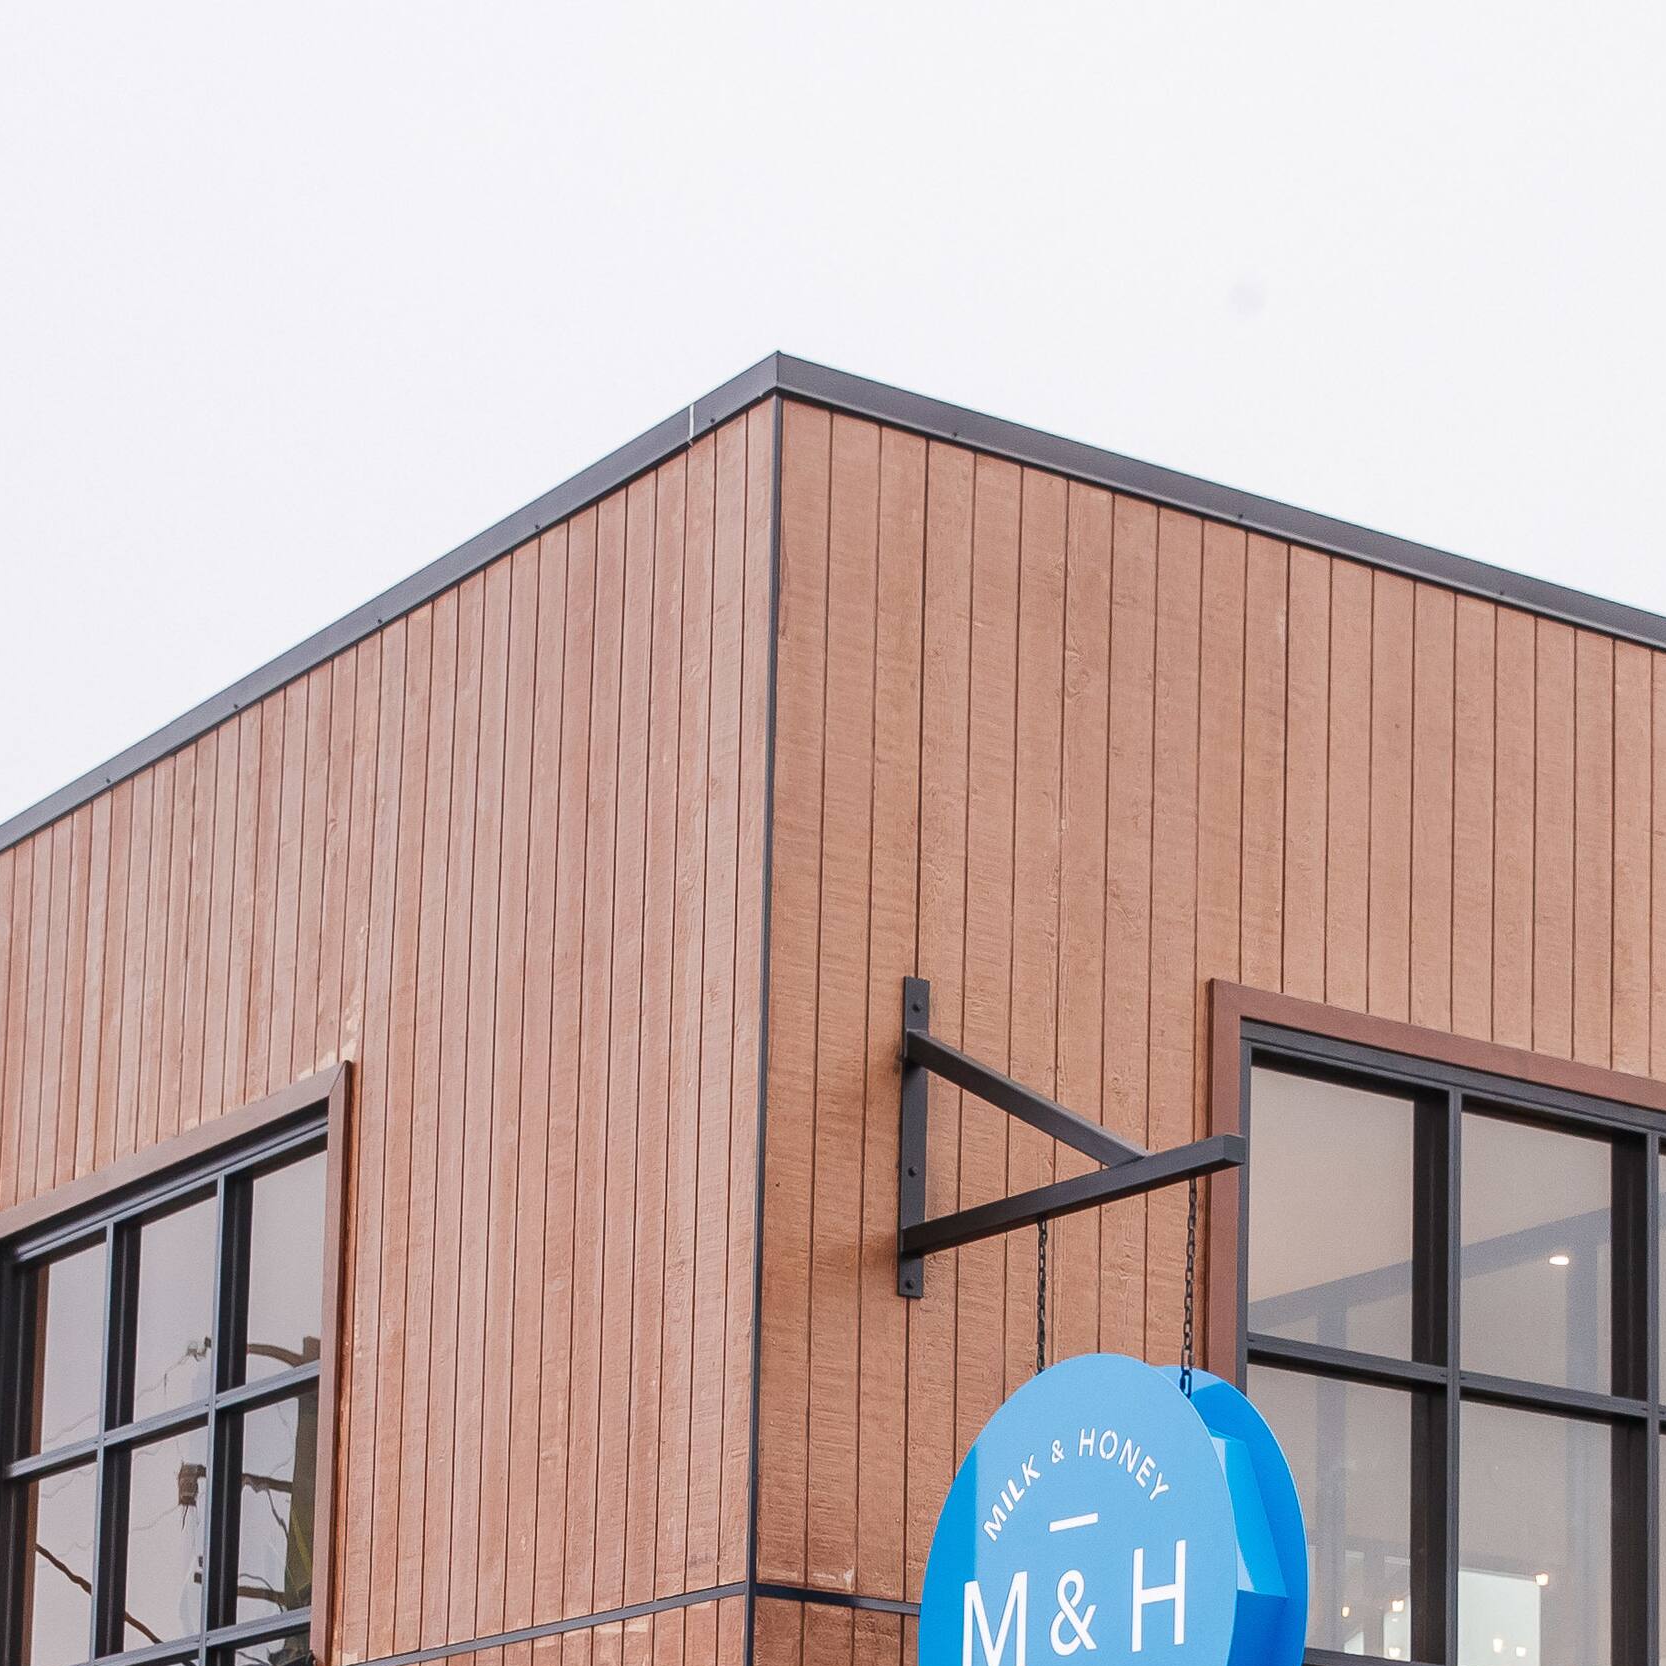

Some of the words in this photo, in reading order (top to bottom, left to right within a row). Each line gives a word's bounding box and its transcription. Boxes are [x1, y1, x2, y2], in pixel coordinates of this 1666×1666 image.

[983, 1454, 1041, 1541] MILK
[1051, 1439, 1065, 1464] &
[1078, 1427, 1169, 1501] HONEY
[1049, 1569, 1097, 1656] &
[1131, 1539, 1187, 1653] H
